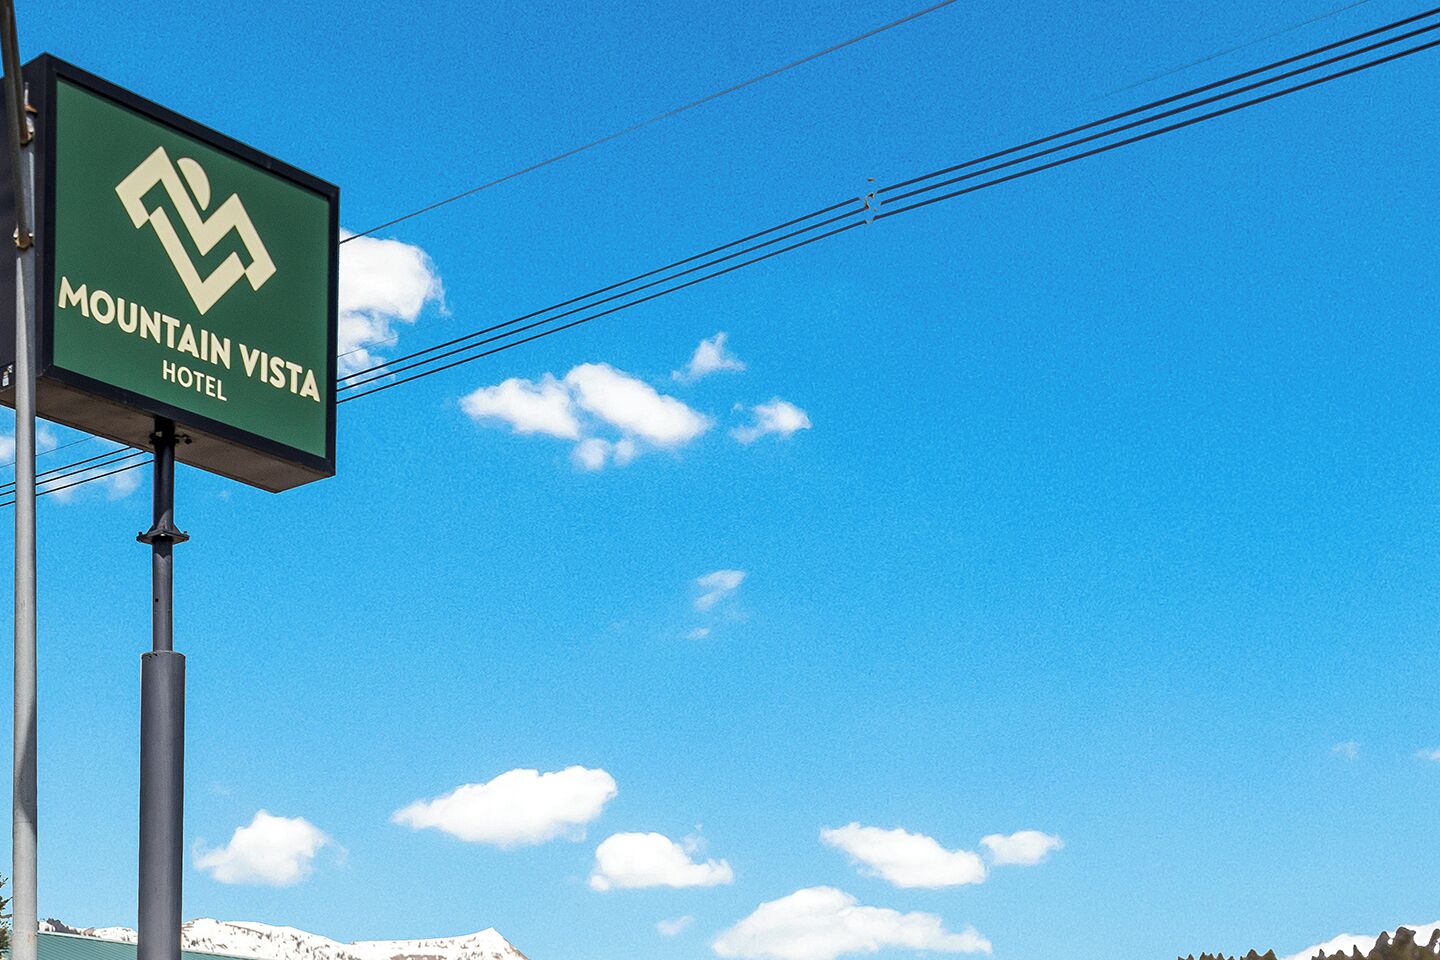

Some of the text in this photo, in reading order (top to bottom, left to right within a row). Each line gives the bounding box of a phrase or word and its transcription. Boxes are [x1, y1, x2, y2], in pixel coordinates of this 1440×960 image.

[58, 276, 321, 403] MOUNTAIN VISTA
[162, 359, 228, 402] HOTEL
